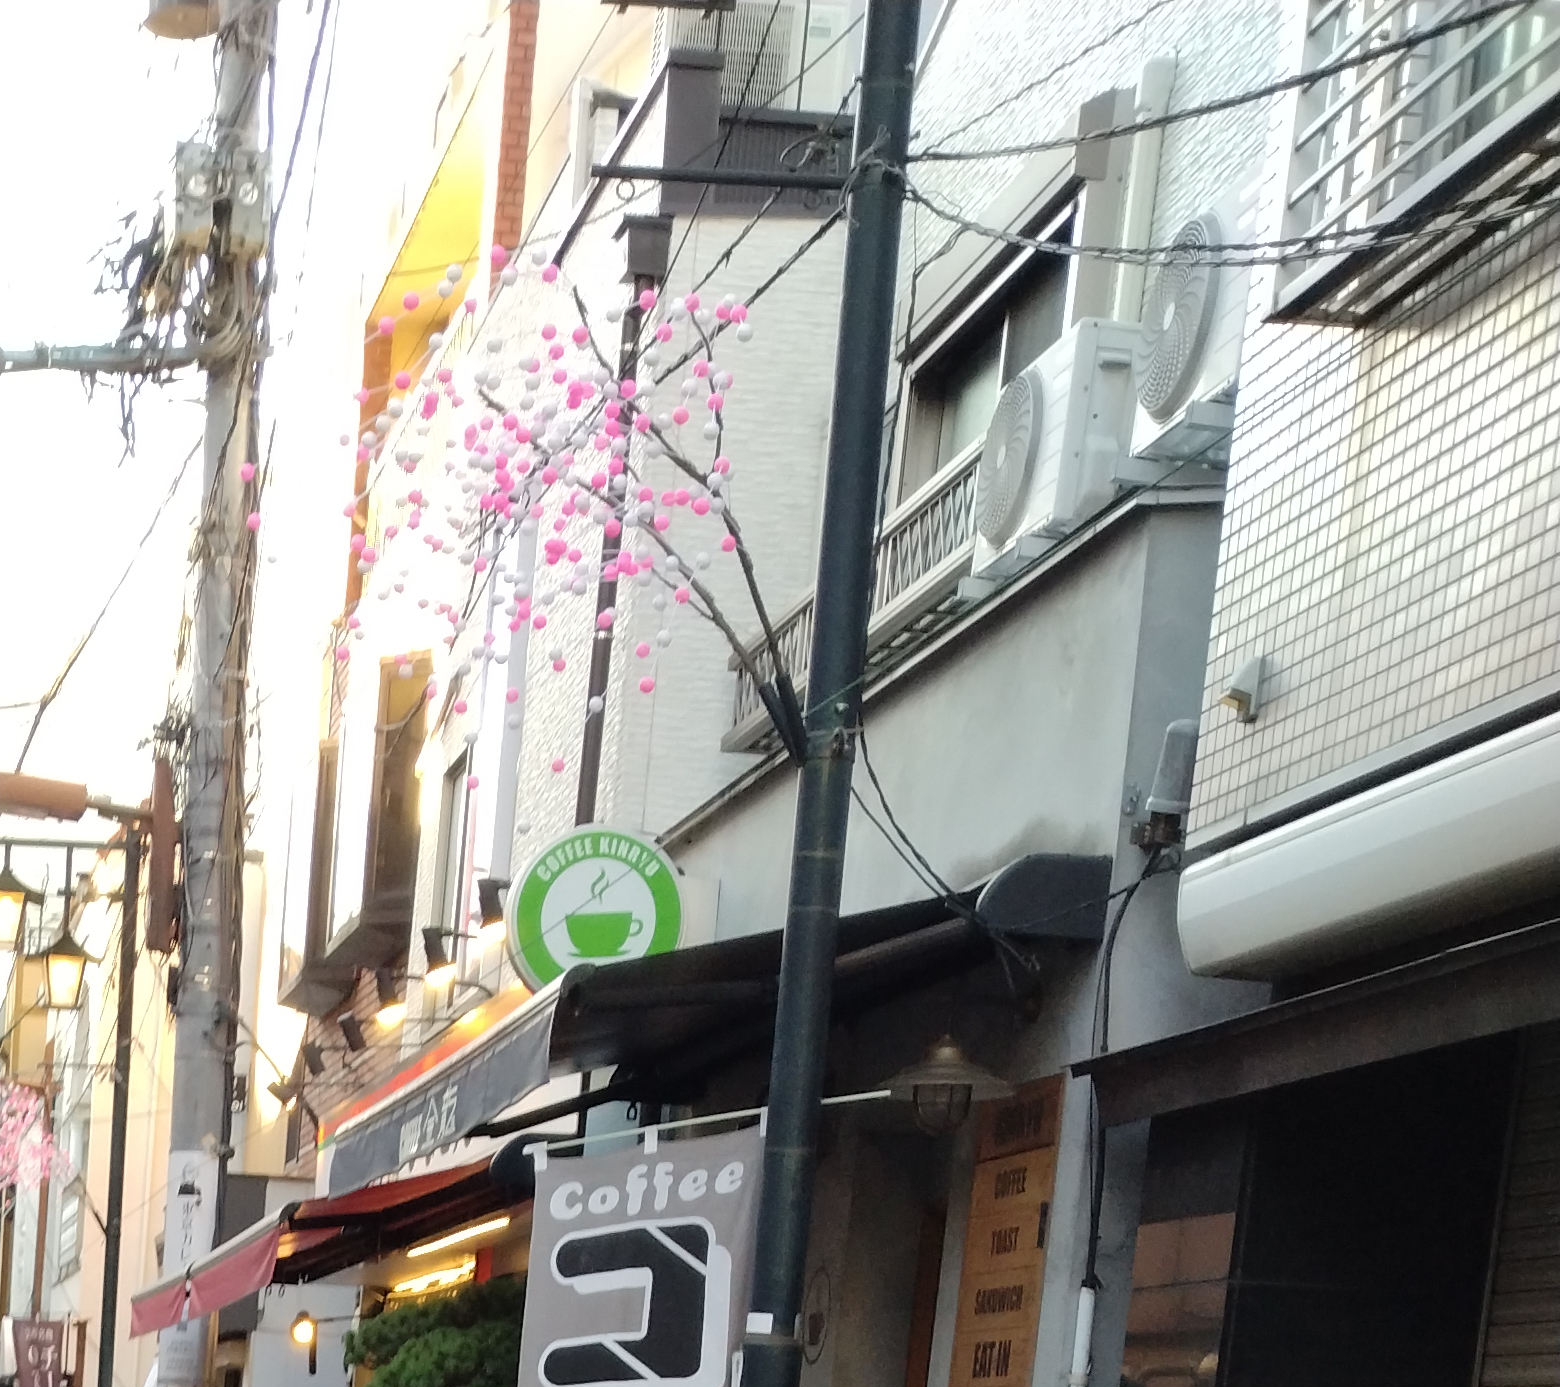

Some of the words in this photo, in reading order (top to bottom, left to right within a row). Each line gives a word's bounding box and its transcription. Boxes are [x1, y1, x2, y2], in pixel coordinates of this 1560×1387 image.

[536, 837, 594, 882] COFFEE
[599, 836, 661, 878] KINRYU
[550, 1161, 745, 1221] Coffee
[994, 1167, 1028, 1200] COFFEE
[991, 1226, 1020, 1257] TOAST
[974, 1284, 1025, 1315] SANDWICH
